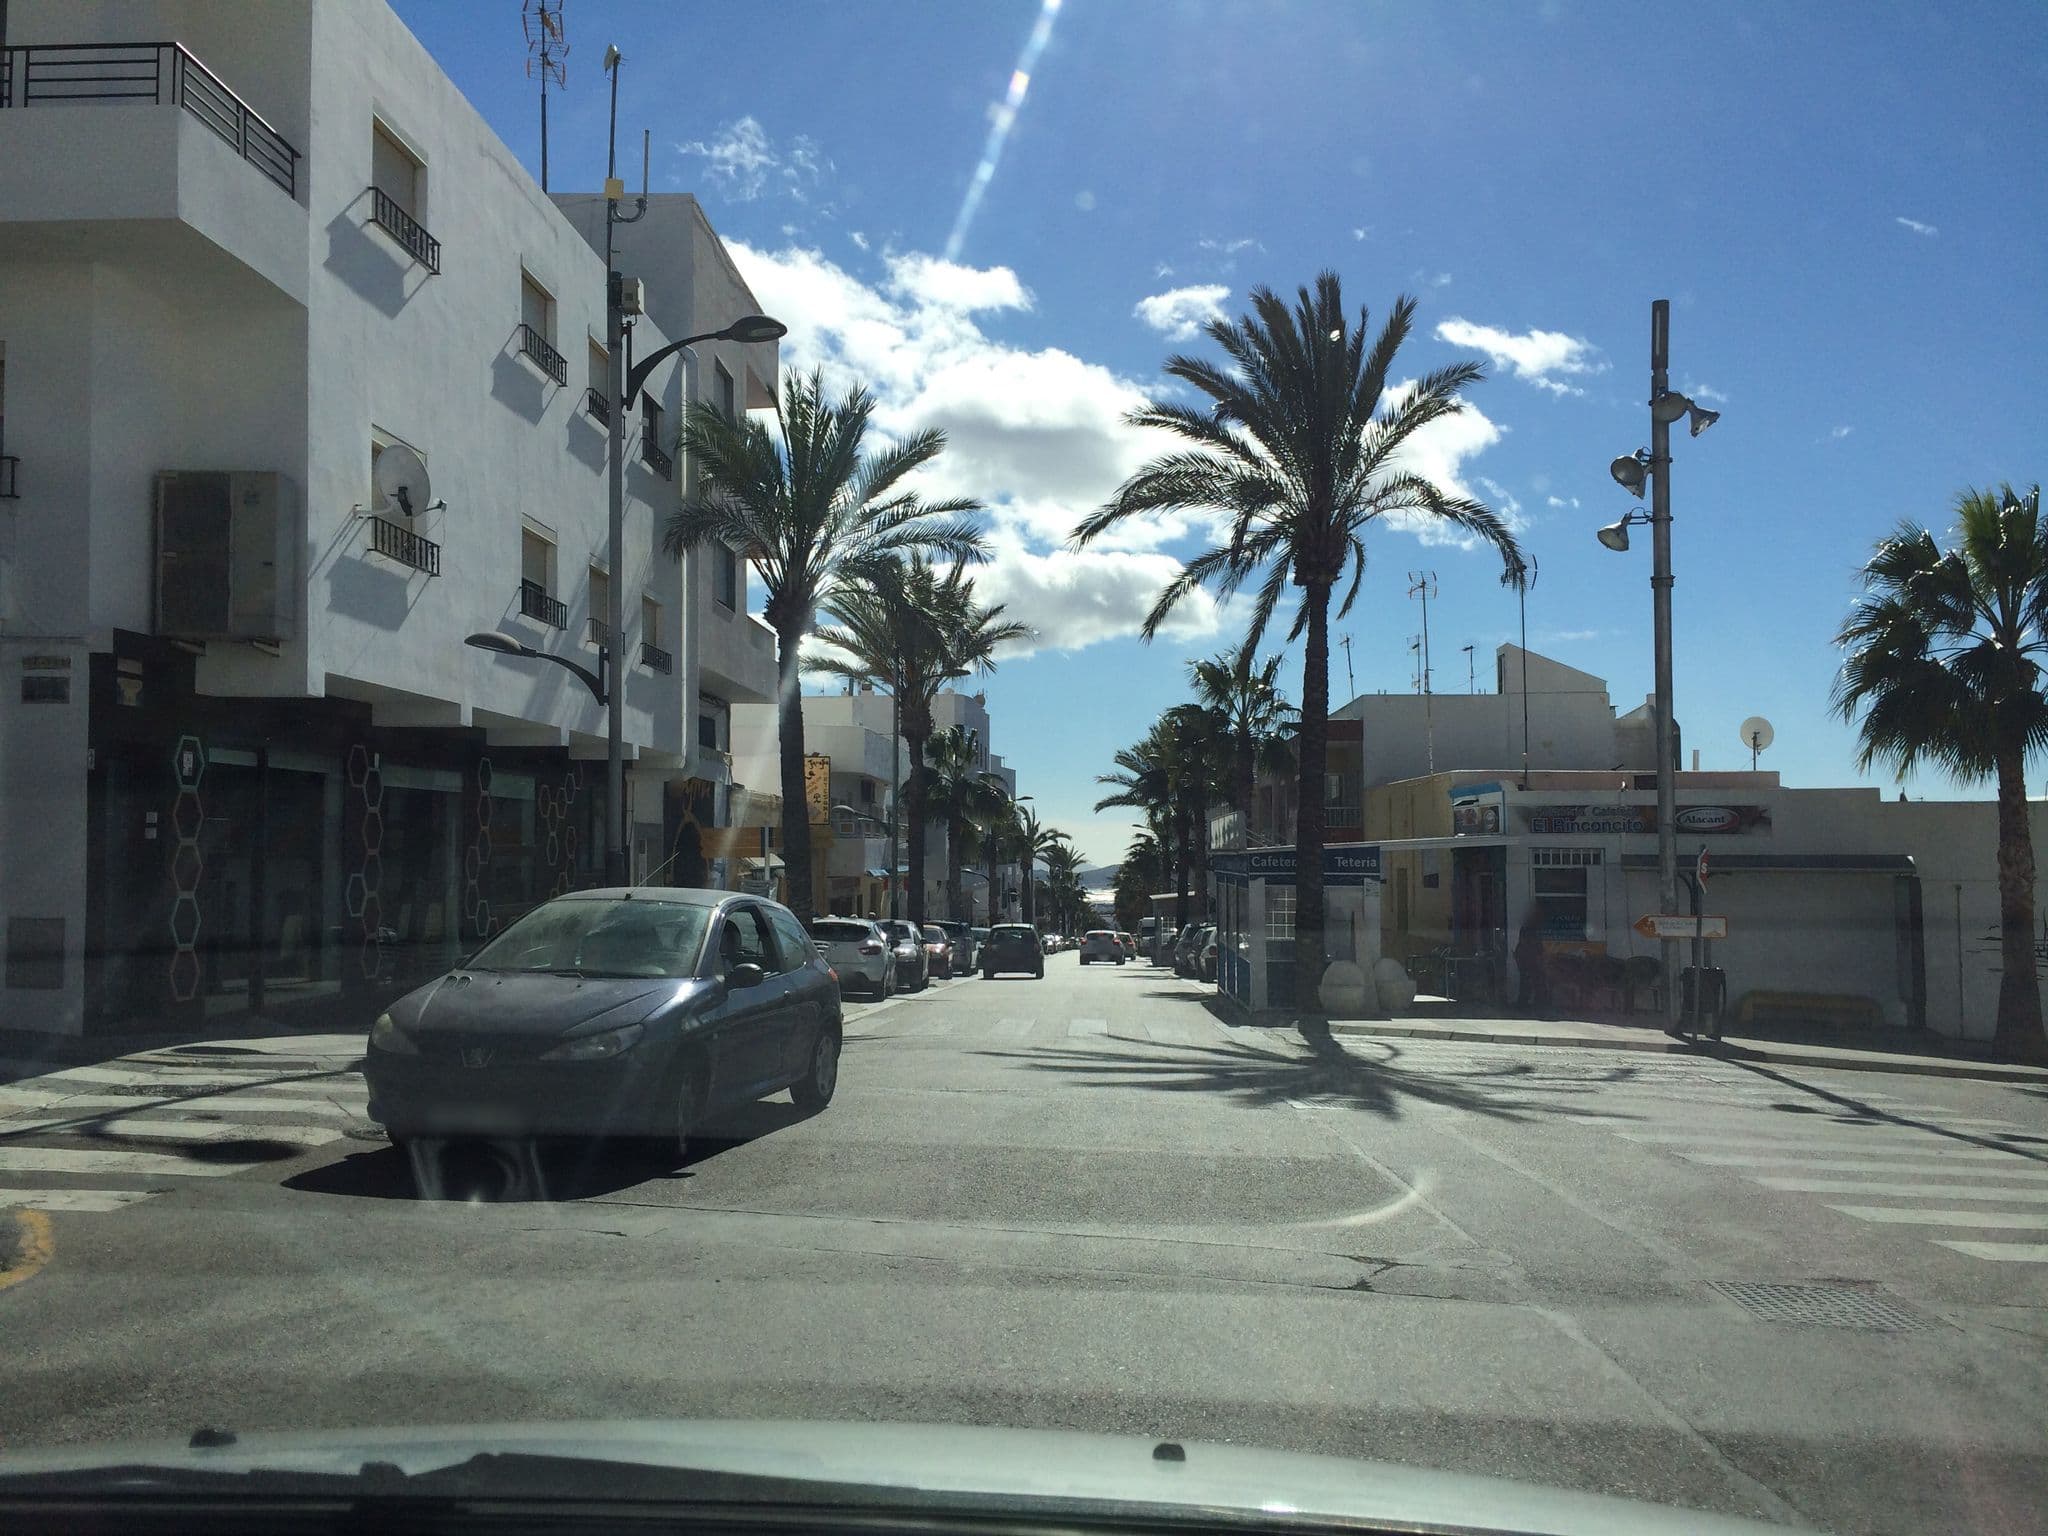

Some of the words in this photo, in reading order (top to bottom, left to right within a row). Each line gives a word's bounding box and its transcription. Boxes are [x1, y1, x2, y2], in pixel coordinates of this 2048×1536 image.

[1532, 817, 1547, 833] El
[1552, 816, 1644, 833] Rinconcito
[1683, 815, 1725, 824] Alacant
[1251, 855, 1297, 867] Cafeter
[1333, 856, 1377, 867] Tetería
